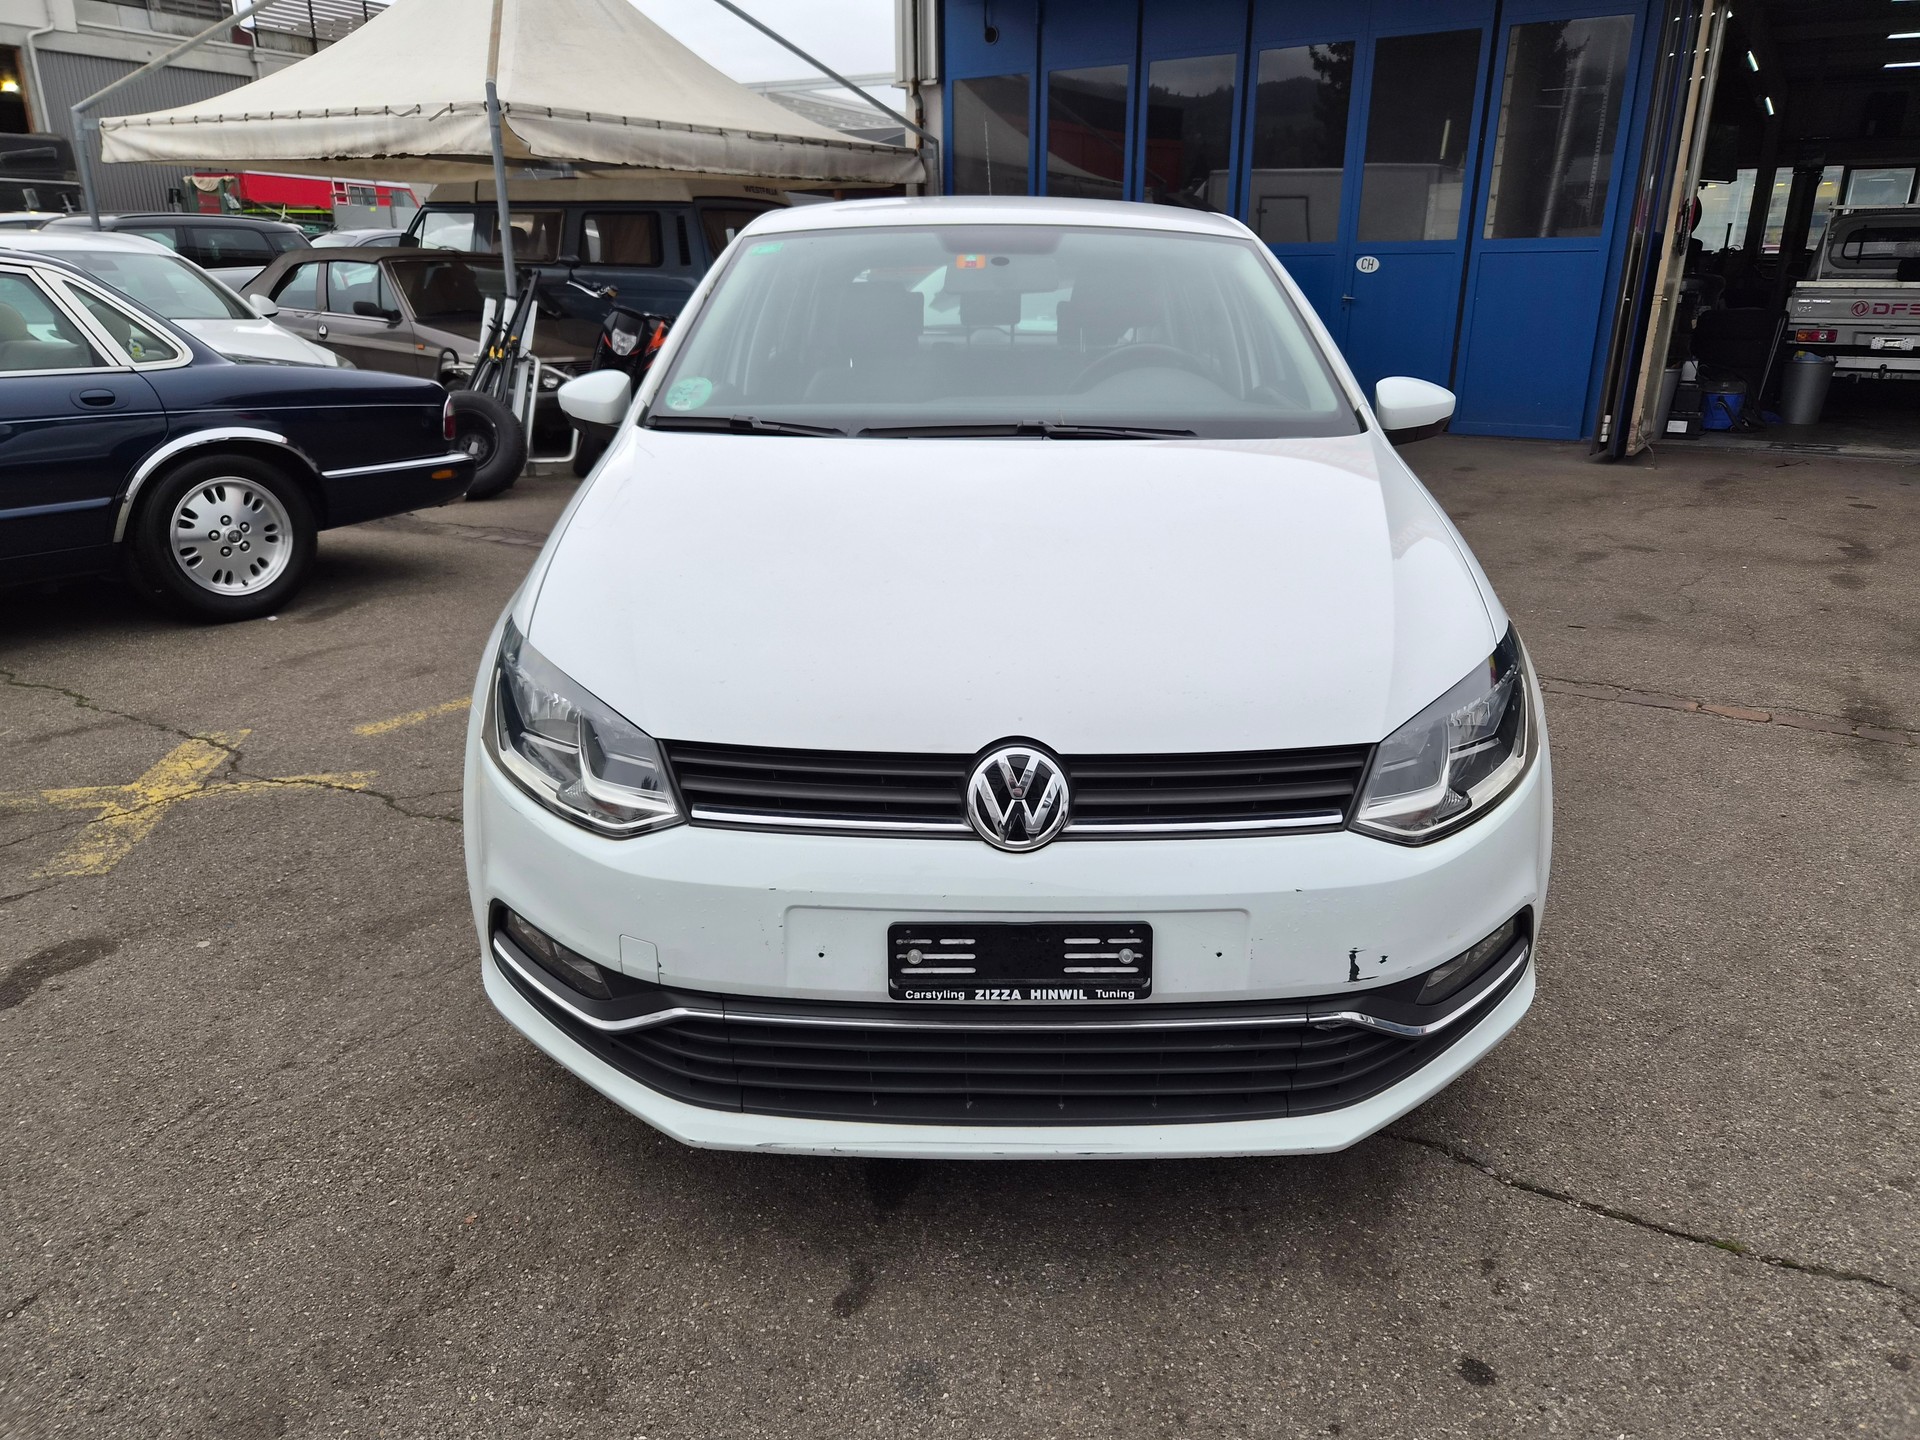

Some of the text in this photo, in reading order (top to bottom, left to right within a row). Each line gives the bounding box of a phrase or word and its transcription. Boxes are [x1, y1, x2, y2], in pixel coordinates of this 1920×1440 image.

[1361, 258, 1374, 270] CH
[970, 749, 1066, 847] VW
[905, 989, 1135, 1001] Carstyling ZIZZA HINWIL Tuning
